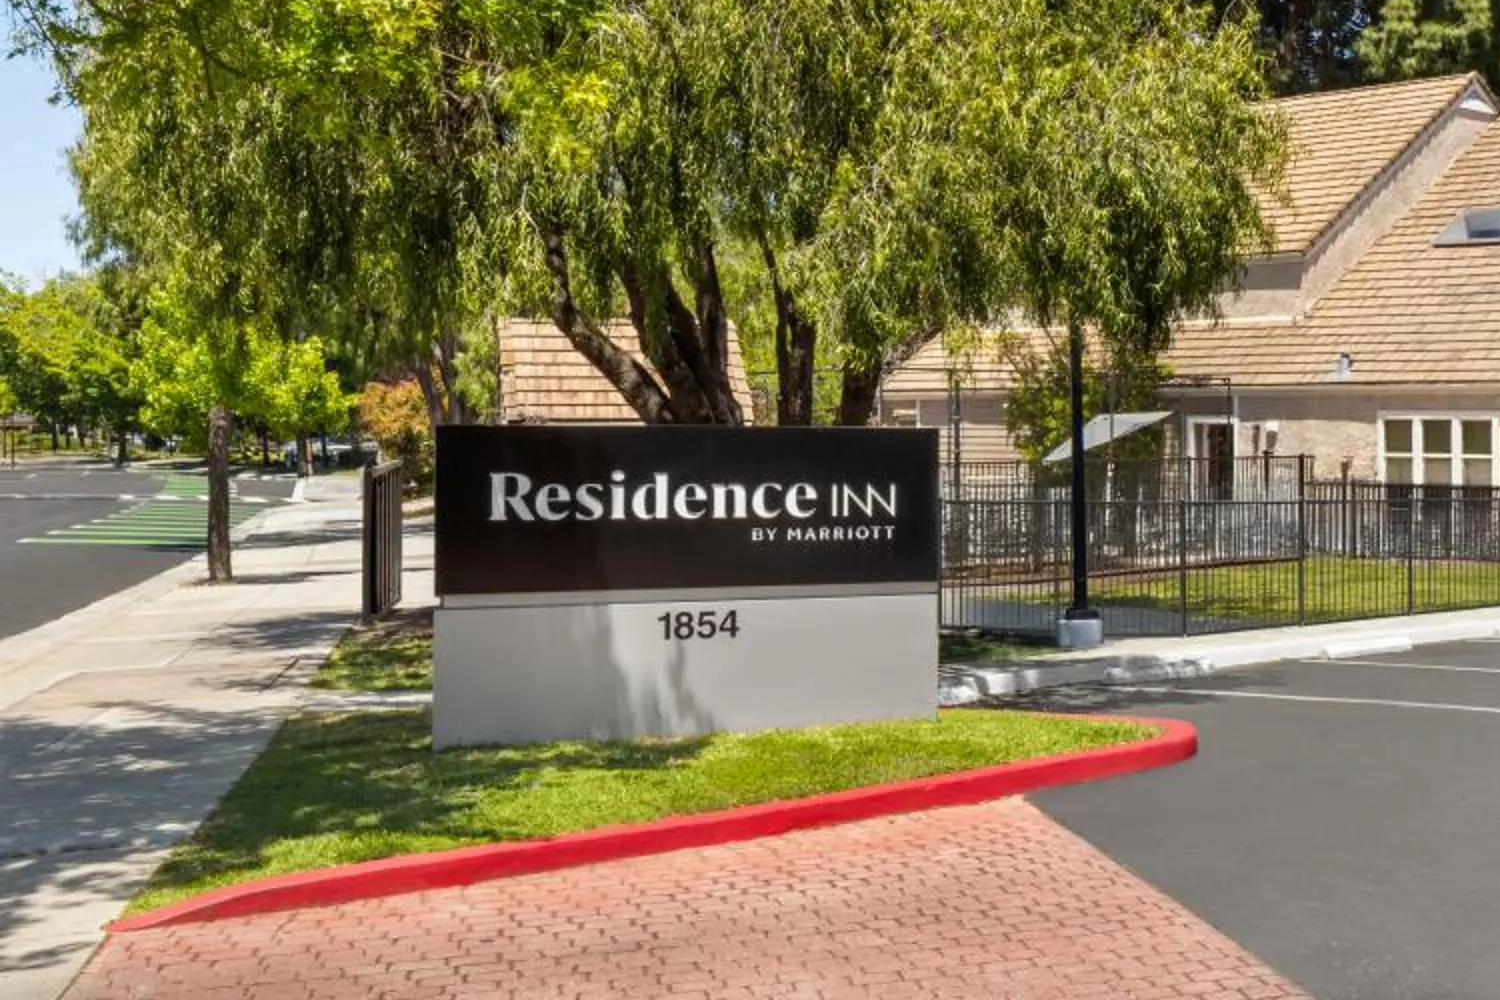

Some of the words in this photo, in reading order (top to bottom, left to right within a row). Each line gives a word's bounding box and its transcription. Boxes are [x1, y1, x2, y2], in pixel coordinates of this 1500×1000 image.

[489, 469, 818, 521] Residence
[831, 483, 897, 518] INN
[752, 527, 778, 542] BY
[786, 525, 895, 542] MARRIOTT
[657, 610, 740, 641] 1854
